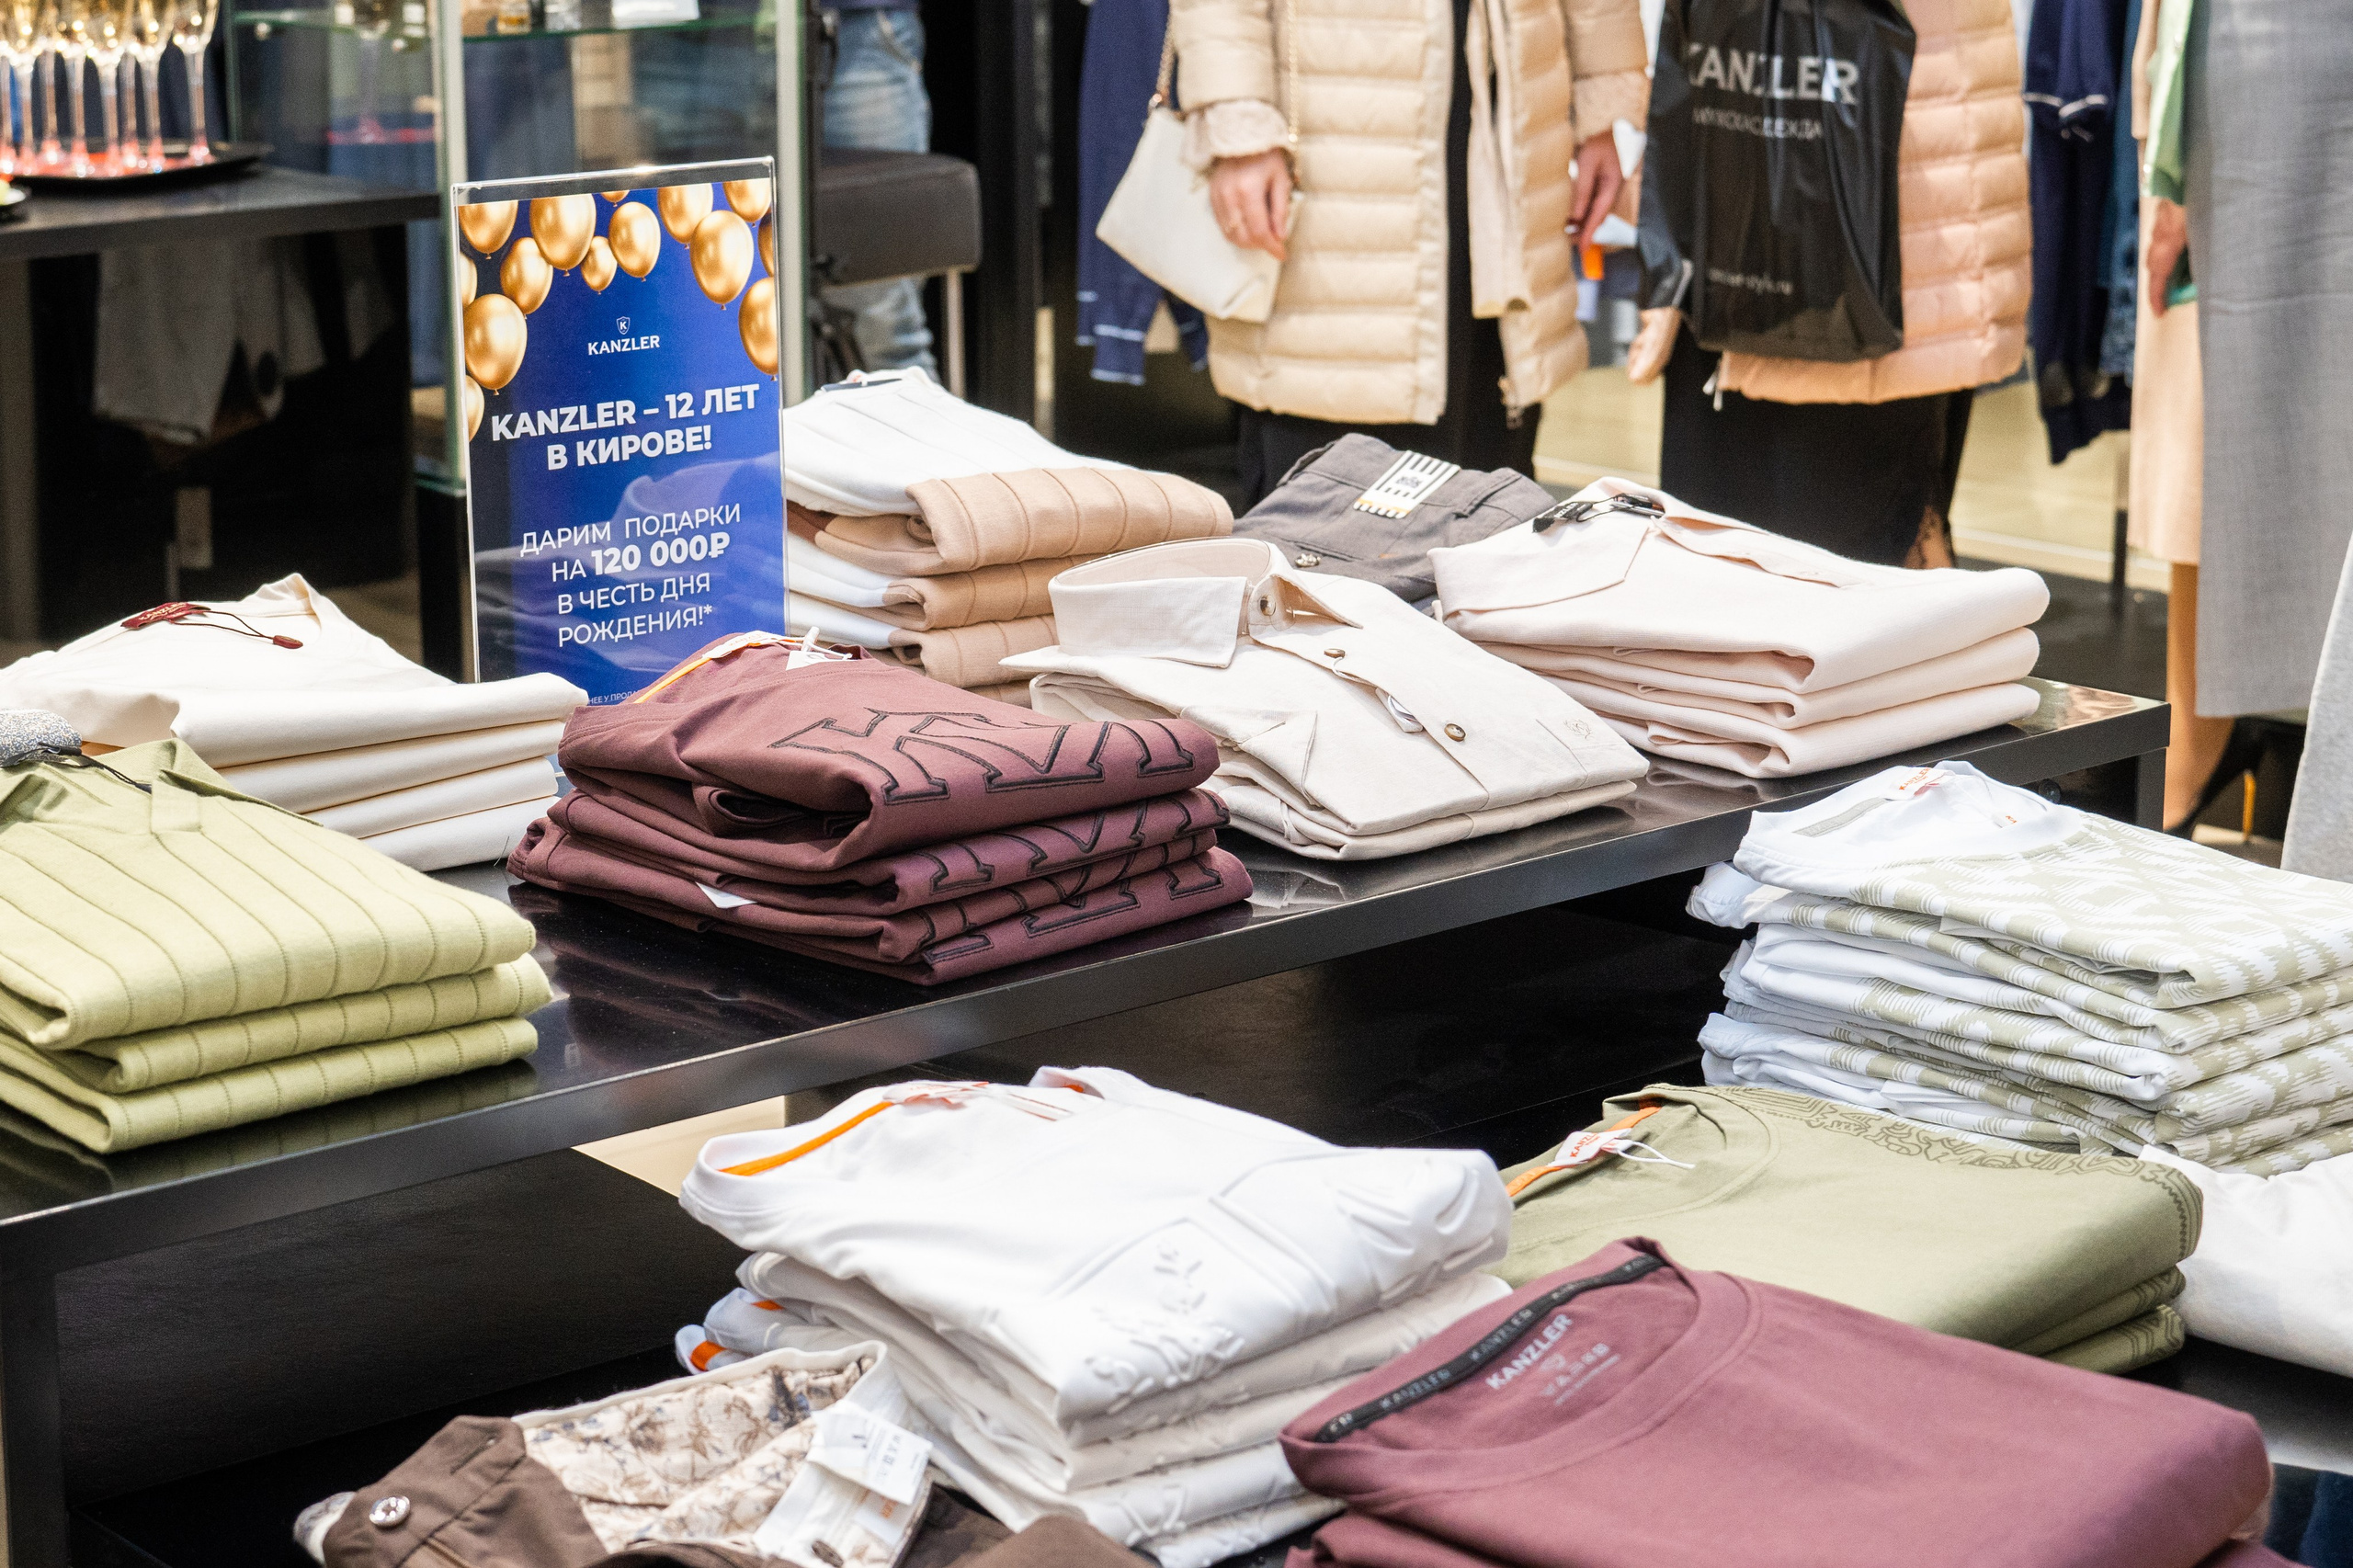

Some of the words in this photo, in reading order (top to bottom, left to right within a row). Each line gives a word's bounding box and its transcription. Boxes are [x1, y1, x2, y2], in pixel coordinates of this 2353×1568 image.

[587, 335, 661, 356] KANZLER
[492, 399, 637, 442] KANZLER
[665, 392, 695, 420] 12
[701, 383, 760, 415] ЛЕТ
[547, 444, 568, 471] В
[576, 425, 712, 468] КИРОВЕ!
[520, 521, 611, 558] ДАРИМ
[625, 503, 741, 540] ПОДАРКИ
[551, 560, 587, 583] НА
[591, 544, 642, 575] 120
[558, 594, 574, 615] В
[580, 582, 655, 610] ЧЕСТЬ
[661, 572, 711, 604] ДНЯ
[604, 694, 609, 703] У
[610, 690, 638, 701] ПРОД
[1470, 1307, 1534, 1361] KANZLER
[1485, 1313, 1574, 1390] KANZLER
[1380, 1369, 1451, 1410] KANZLER
